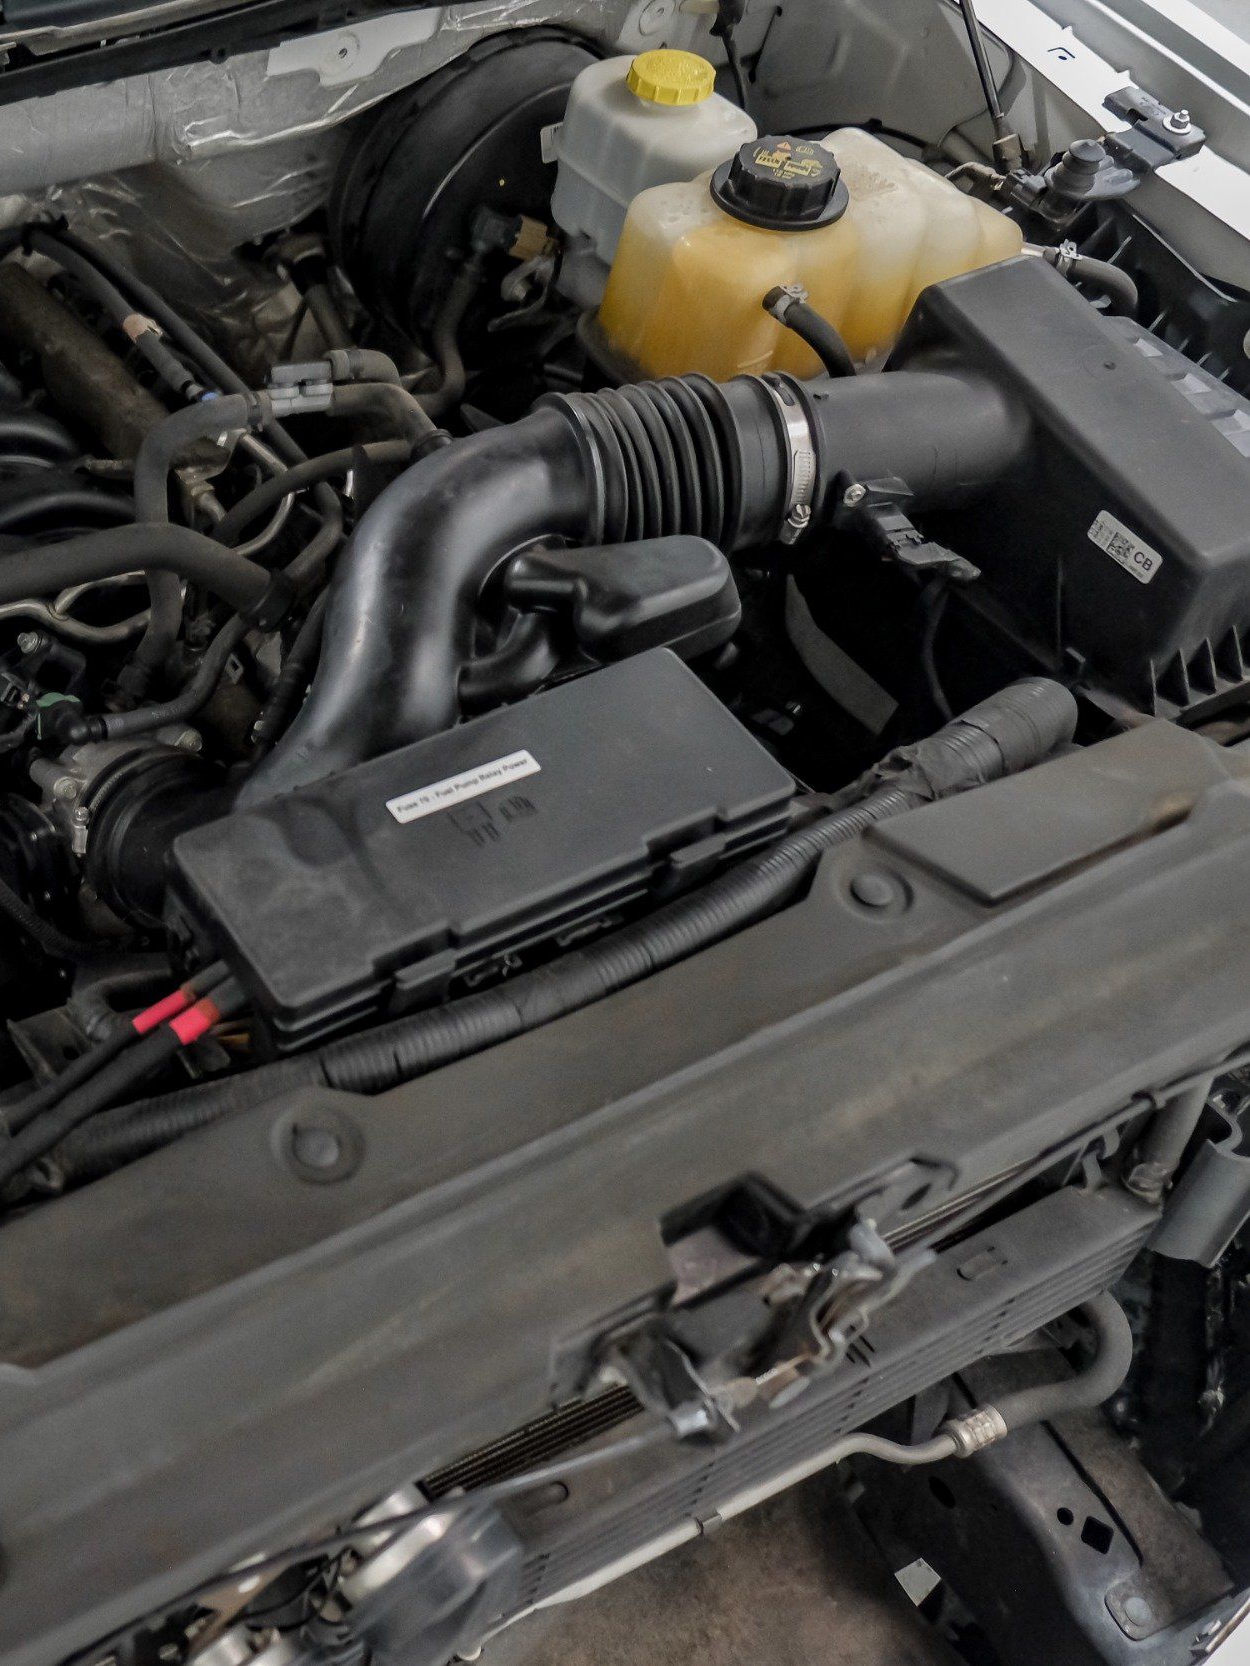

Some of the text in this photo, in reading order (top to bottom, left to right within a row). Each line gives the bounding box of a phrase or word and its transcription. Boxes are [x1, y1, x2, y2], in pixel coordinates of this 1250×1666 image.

[1133, 551, 1153, 571] CB
[397, 800, 418, 813] Fuse
[435, 787, 453, 799] Fuel
[454, 777, 479, 791] Pump
[478, 766, 502, 782] Relay
[502, 759, 527, 773] Power
